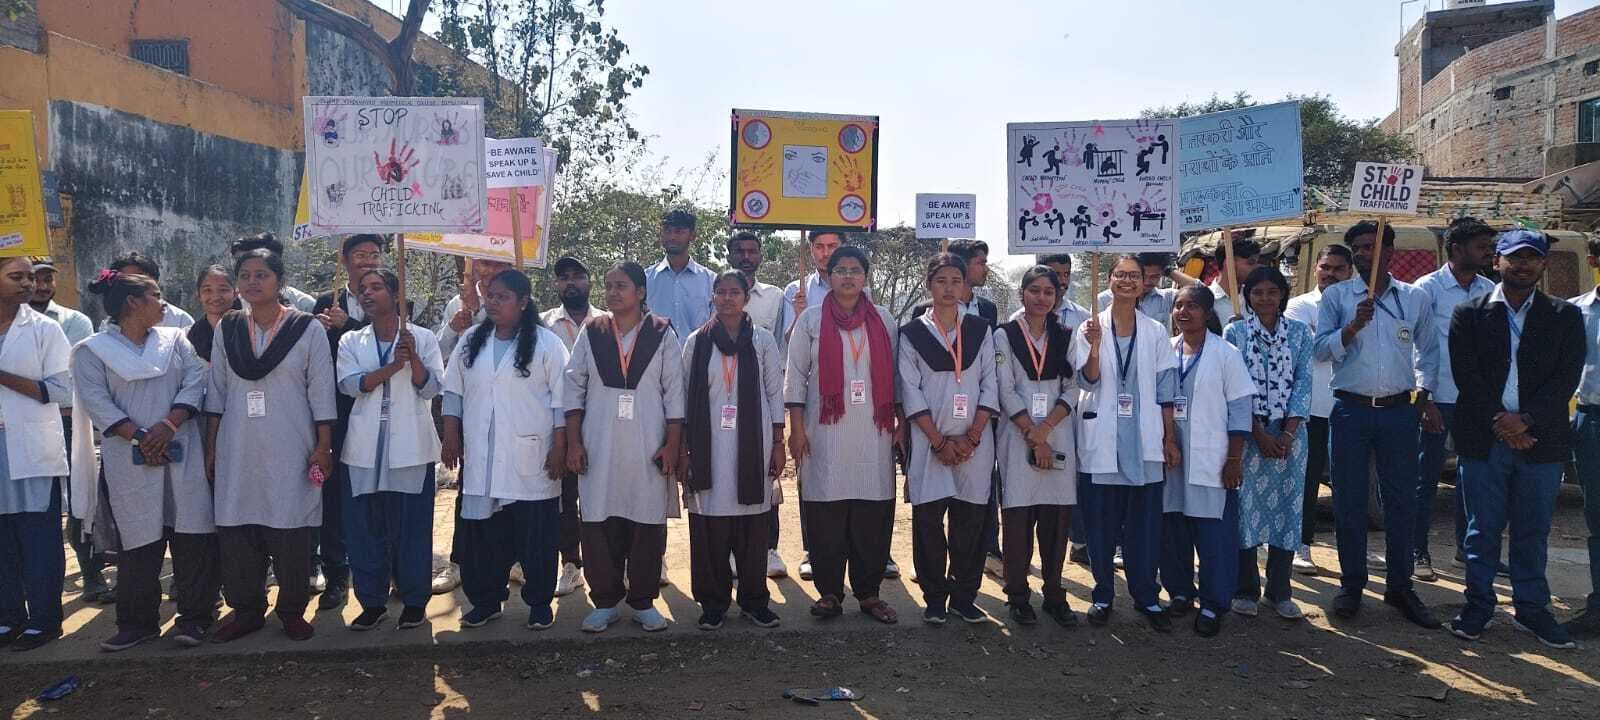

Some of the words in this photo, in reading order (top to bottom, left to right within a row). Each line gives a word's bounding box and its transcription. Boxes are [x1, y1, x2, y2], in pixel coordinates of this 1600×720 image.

[358, 107, 408, 130] STOP
[1236, 115, 1268, 141] और
[504, 146, 537, 155] AWARE
[489, 160, 516, 168] SPEAK
[517, 158, 529, 166] UP
[486, 170, 505, 178] SAVE
[371, 186, 412, 202] CHILD
[1361, 184, 1411, 202] CHILD
[941, 201, 970, 209] AWARE
[1360, 199, 1409, 210] TRAFFICKING
[359, 201, 447, 223] TRAFFICKING
[925, 211, 950, 219] SPEAK
